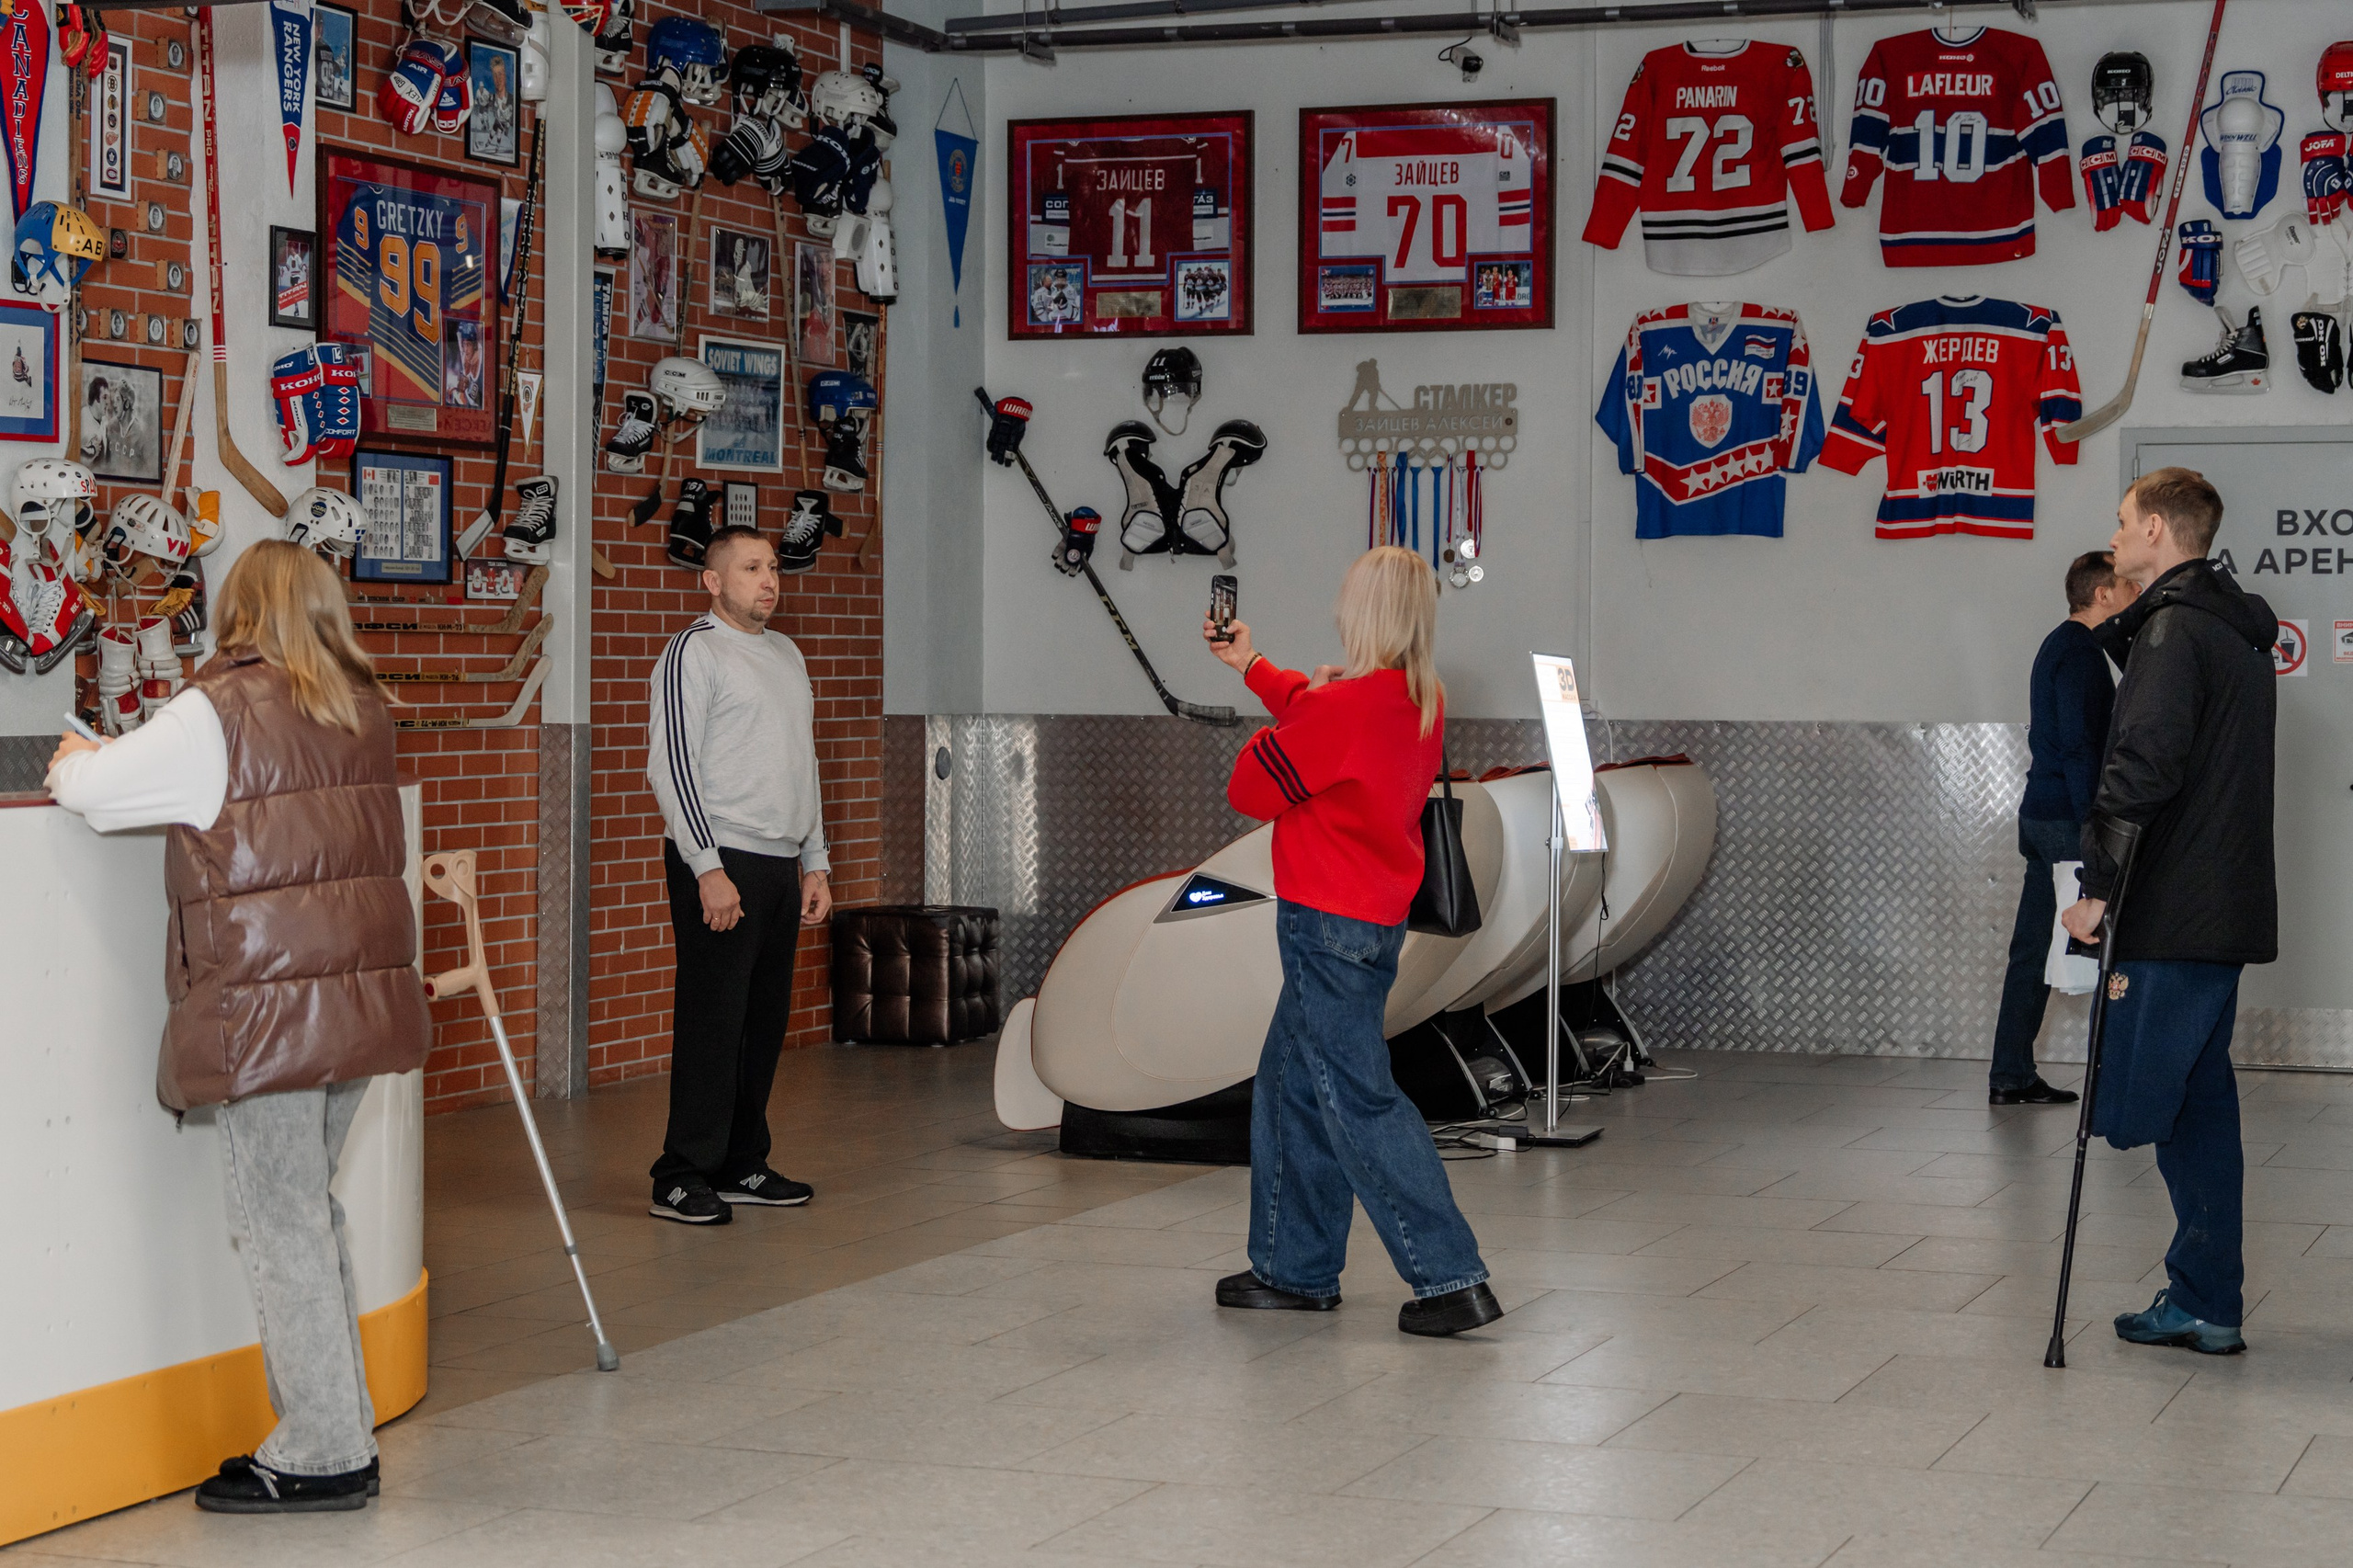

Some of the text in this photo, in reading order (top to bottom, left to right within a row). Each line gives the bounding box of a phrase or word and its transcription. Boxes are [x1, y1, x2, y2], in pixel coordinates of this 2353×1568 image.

[282, 20, 294, 112] RANGERS
[292, 23, 301, 114] NEW YORK
[407, 62, 428, 74] AIR
[1700, 63, 1726, 73] Reebok
[405, 87, 424, 104] FLEX
[1676, 85, 1738, 109] PANARIN
[1856, 77, 1886, 108] 10
[1907, 74, 1994, 98] LAFLEUR
[2022, 79, 2061, 119] 10
[205, 129, 213, 156] PRO
[1665, 115, 1755, 194] 72
[1913, 108, 1989, 184] 10
[2129, 146, 2168, 165] CCM
[2304, 138, 2336, 153] JOFA
[1393, 159, 1461, 187] ЗАЙЦЕВ
[2079, 151, 2117, 169] CCM
[376, 199, 444, 240] GRETZKY
[620, 171, 631, 241] KOHO
[1107, 197, 1156, 268] 11
[1386, 193, 1469, 269] 70
[278, 282, 308, 300] TITAN
[379, 233, 441, 347] 99
[602, 282, 611, 335] TAMPA
[707, 348, 779, 377] SOVIET WINGS
[1152, 357, 1167, 367] 11
[1922, 336, 2000, 364] ЖЕРДЕВ
[2047, 344, 2073, 372] 13
[664, 369, 687, 379] CCM
[1662, 358, 1764, 400] РОССИЯ
[1414, 382, 1518, 412] СТАЛКЕР
[1355, 415, 1504, 433] ЗАЙЦЕВ АЛЕКСЕЙ
[1921, 369, 1995, 455] 13
[704, 446, 778, 465] MONTREAL
[1099, 596, 1140, 651] CCM
[1557, 667, 1575, 691] 3D
